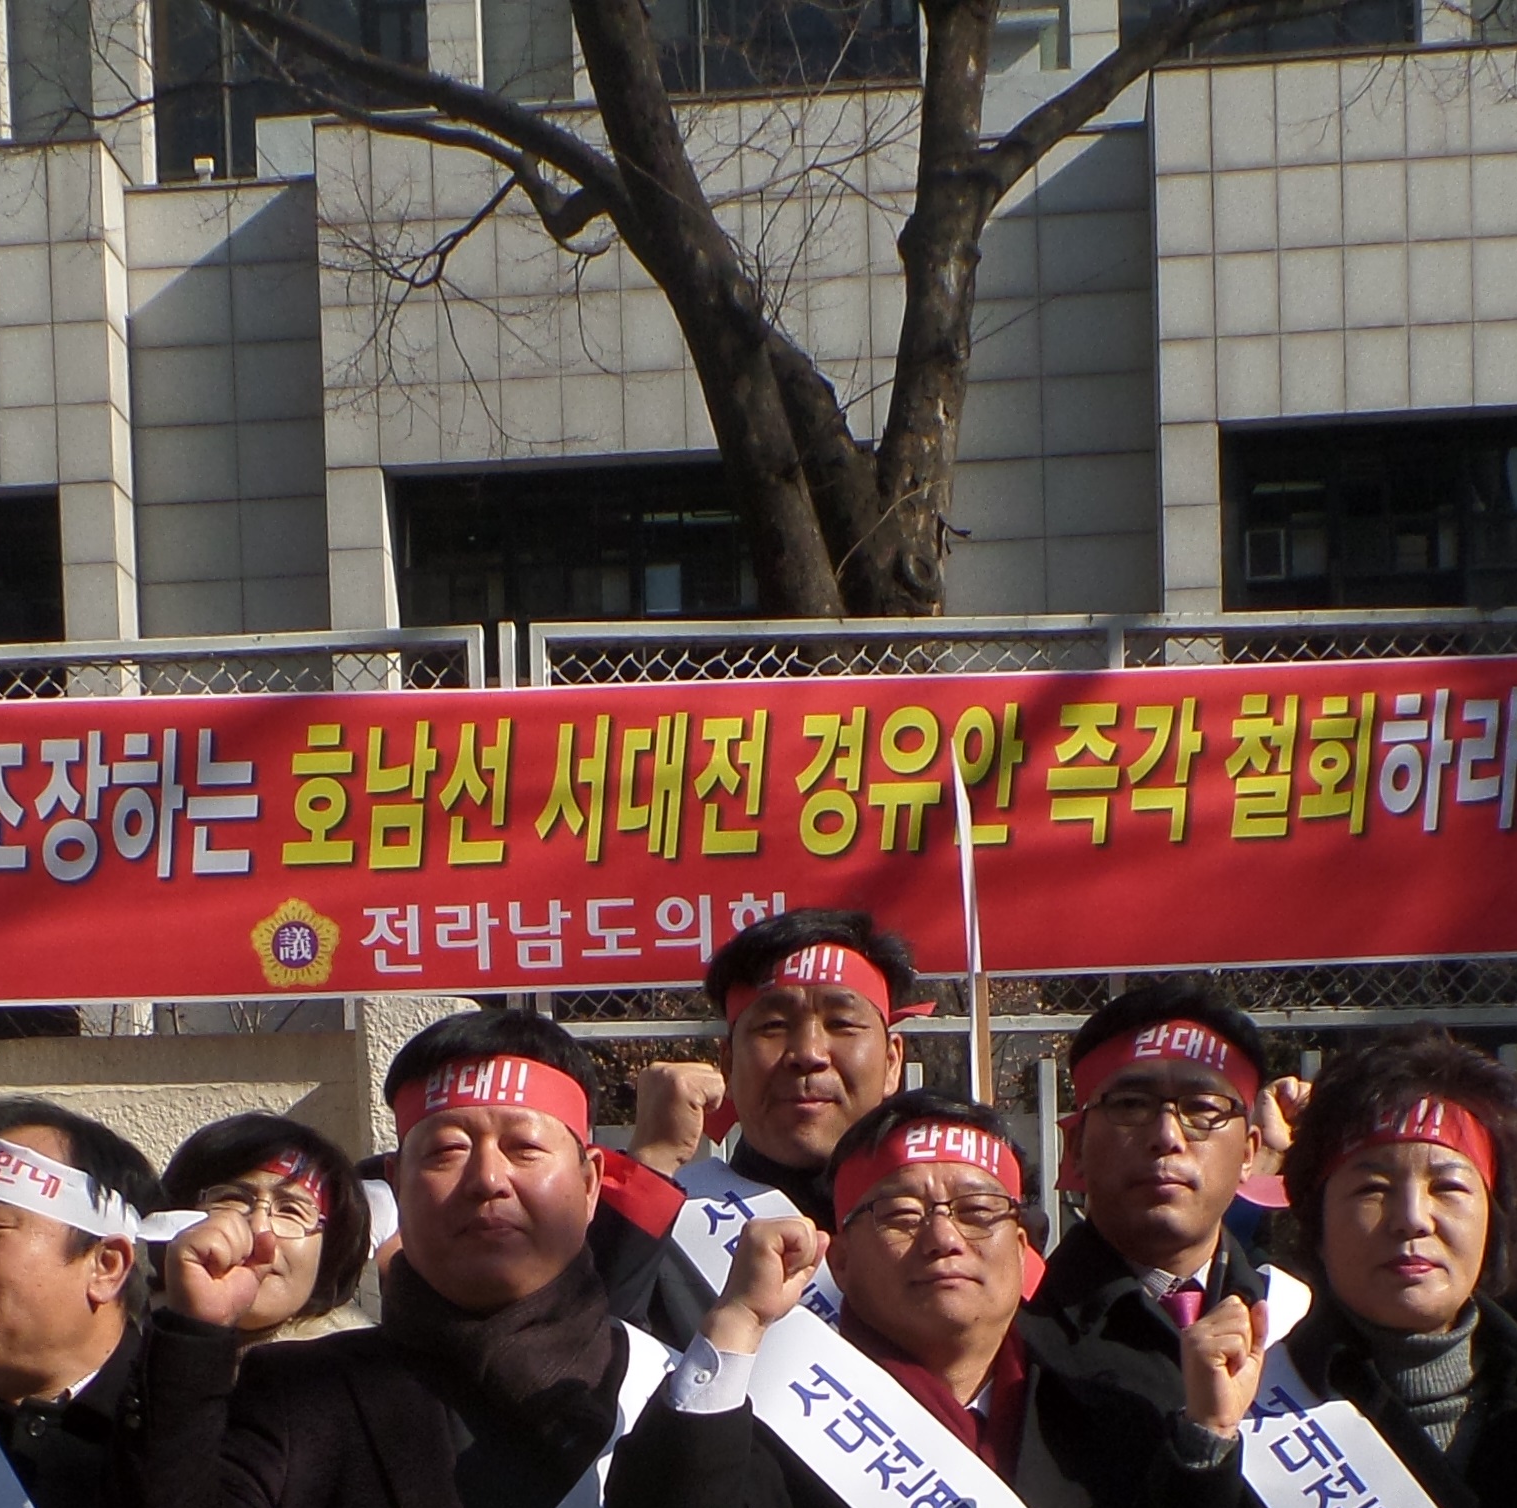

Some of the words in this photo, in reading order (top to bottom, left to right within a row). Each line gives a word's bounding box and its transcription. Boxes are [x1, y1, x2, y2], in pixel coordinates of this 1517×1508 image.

[282, 717, 511, 870] 호남선
[535, 710, 770, 862] 서대전
[795, 704, 1024, 856] 경유안
[1046, 696, 1202, 845] 즉각
[278, 927, 313, 962] 議
[1135, 1025, 1229, 1071] 반대!!
[425, 1060, 528, 1110] 반대!!
[904, 1123, 1000, 1176] 반대!!
